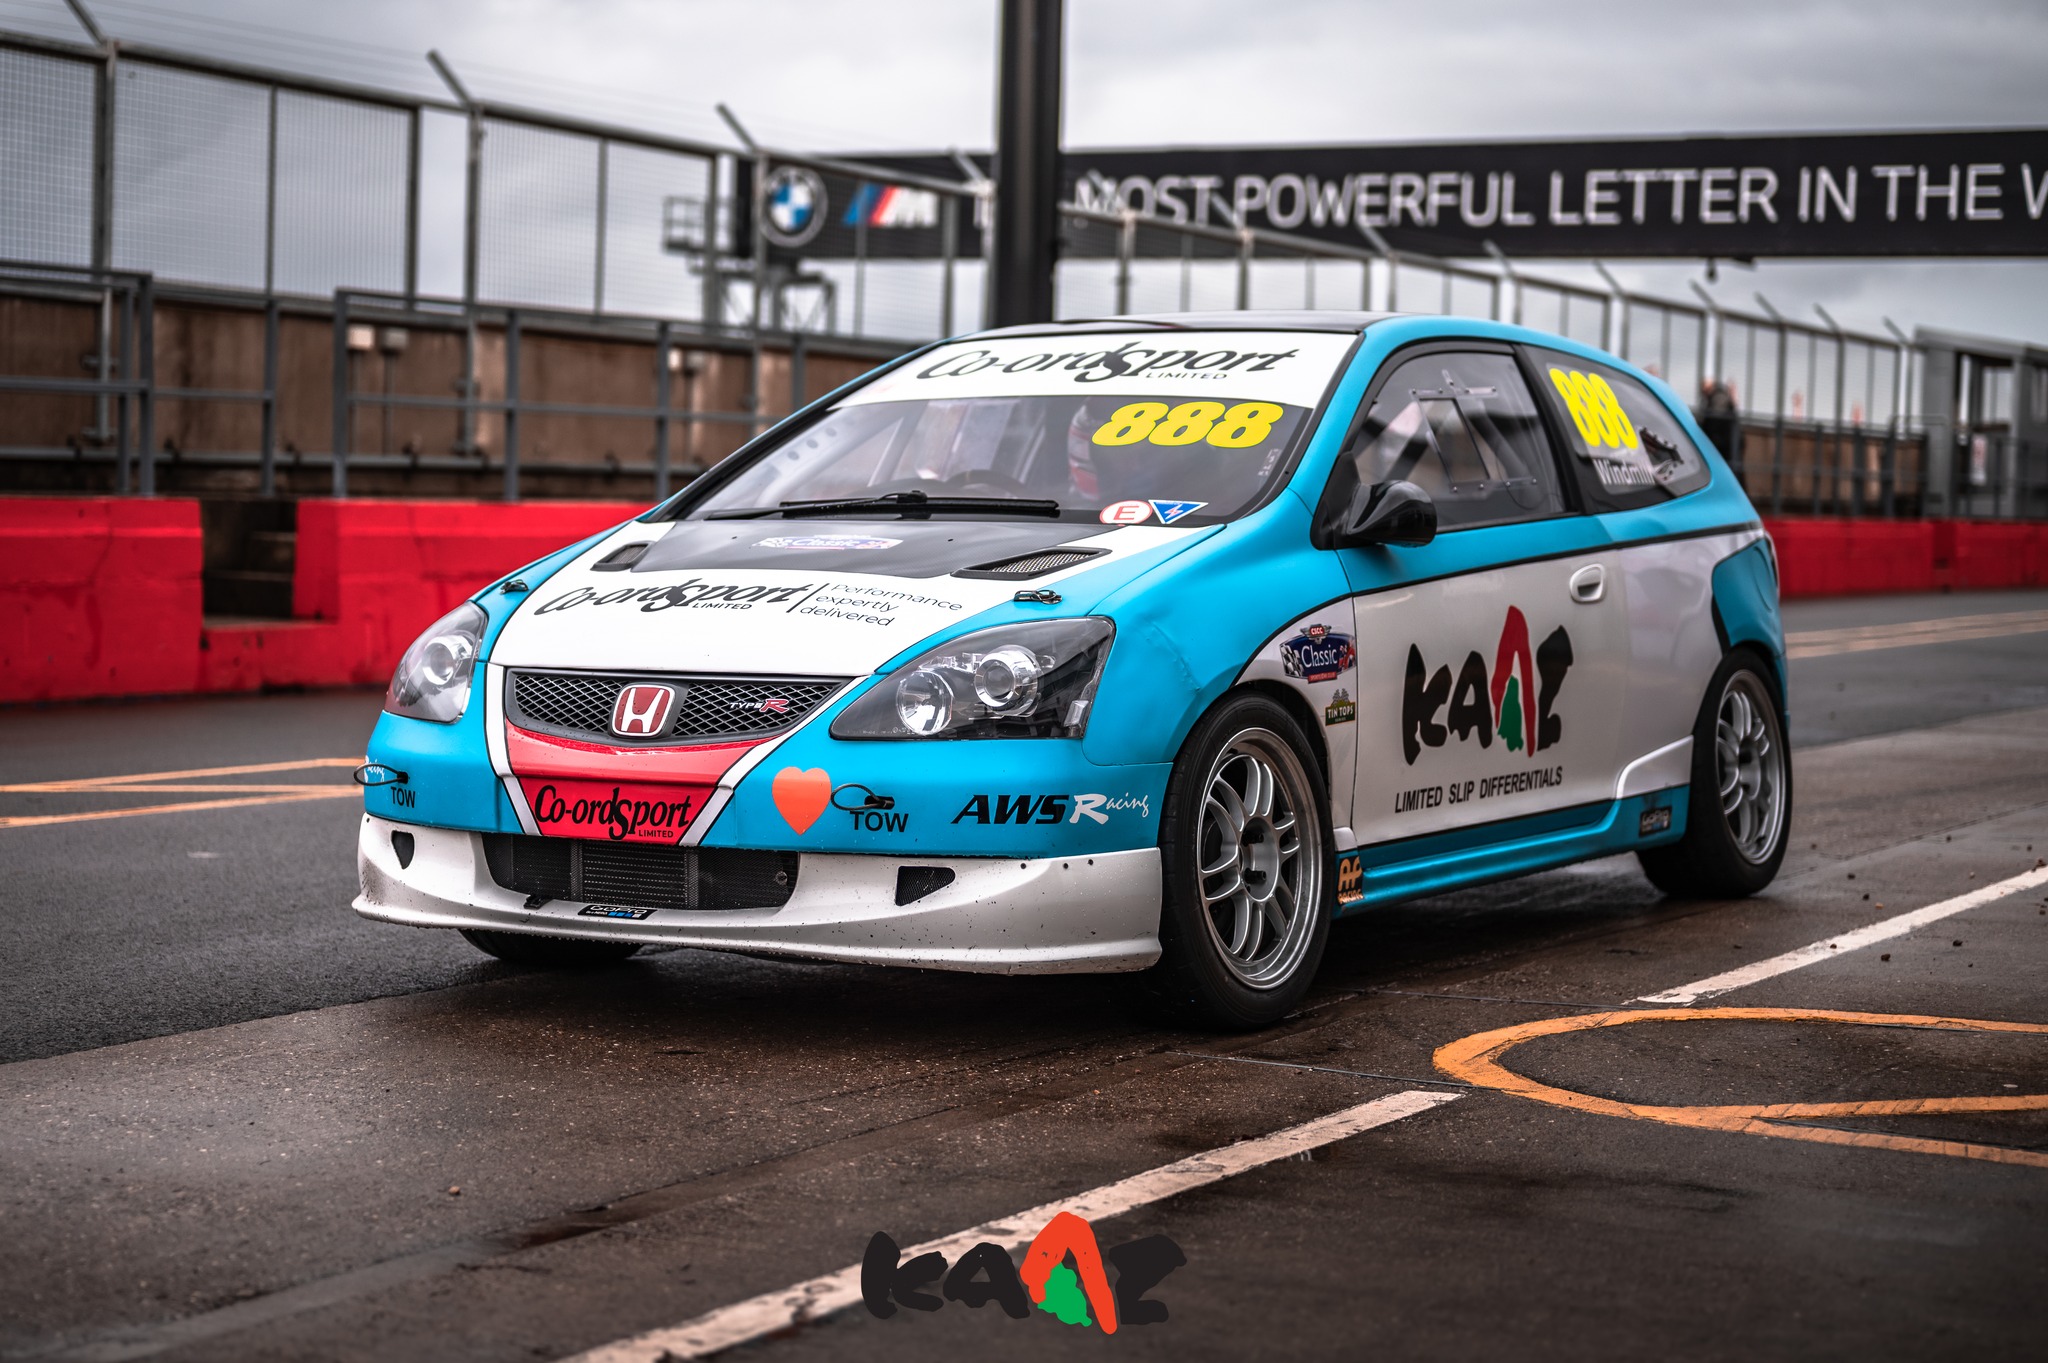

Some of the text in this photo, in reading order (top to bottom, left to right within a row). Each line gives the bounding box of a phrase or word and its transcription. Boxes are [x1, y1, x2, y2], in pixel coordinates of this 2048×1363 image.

[1074, 174, 1222, 227] MOST
[1234, 171, 1535, 228] POWERFUL
[1549, 167, 1779, 226] LETTER
[1799, 166, 1857, 223] IN
[1871, 163, 2005, 221] THE
[1145, 371, 1228, 381] LIMITED
[1549, 368, 1639, 450] 888
[1091, 401, 1284, 448] 888
[692, 602, 752, 612] LIMITED
[815, 595, 899, 613] expertly
[831, 583, 963, 612] Performance
[799, 606, 896, 627] delivered
[1301, 644, 1338, 668] Classic
[1327, 707, 1338, 719] TIN
[1339, 705, 1354, 717] TOPS
[391, 786, 416, 808] TOW
[1394, 766, 1563, 813] LIMITED SLIP DIFFERENTIALS
[951, 792, 1149, 825] AWS Racing
[849, 811, 909, 833] TOW
[638, 829, 674, 838] LIMITED
